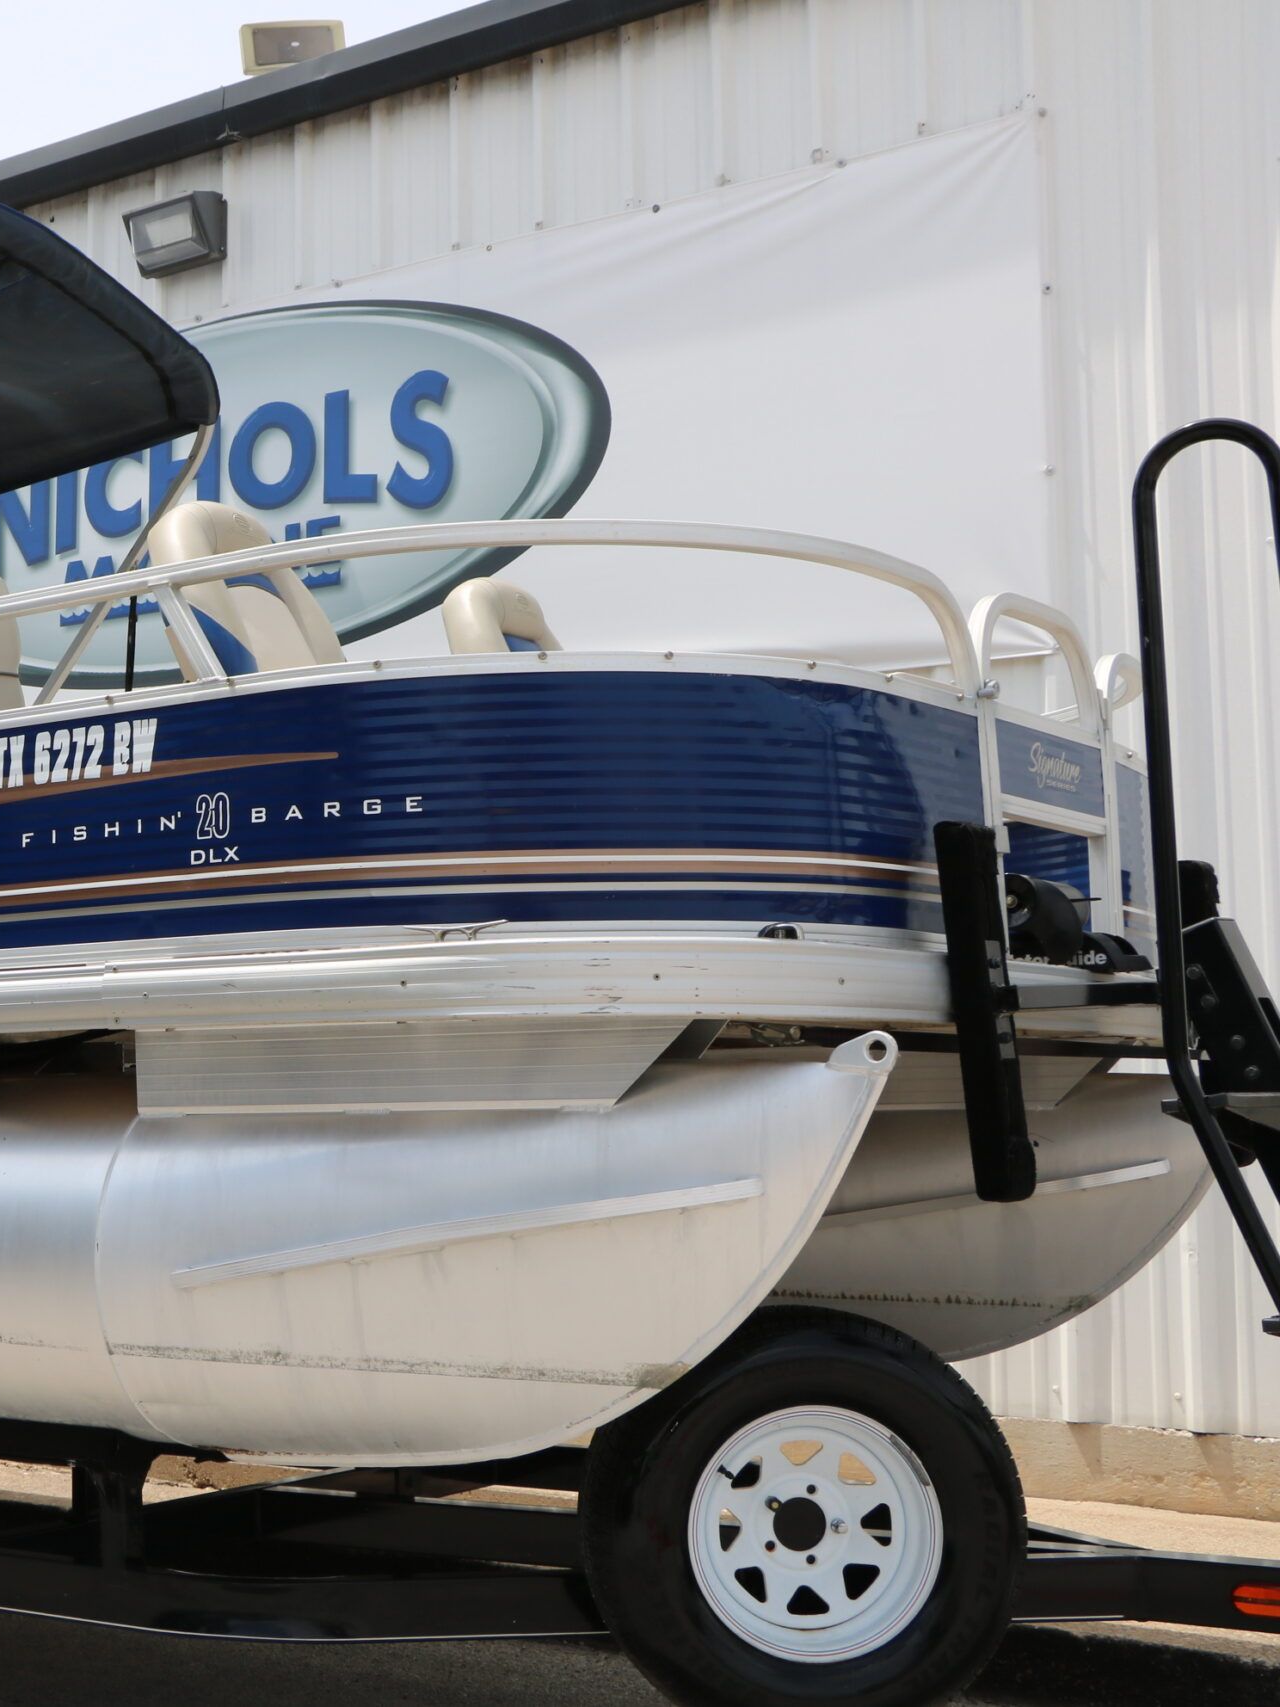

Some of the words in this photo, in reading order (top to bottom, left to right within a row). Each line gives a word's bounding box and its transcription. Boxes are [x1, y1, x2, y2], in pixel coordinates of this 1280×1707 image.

[33, 724, 106, 785] 6272
[112, 718, 158, 777] BW
[21, 811, 182, 848] FISHIN'
[195, 791, 231, 841] 20
[250, 795, 424, 824] BARGE
[189, 845, 240, 866] DLX
